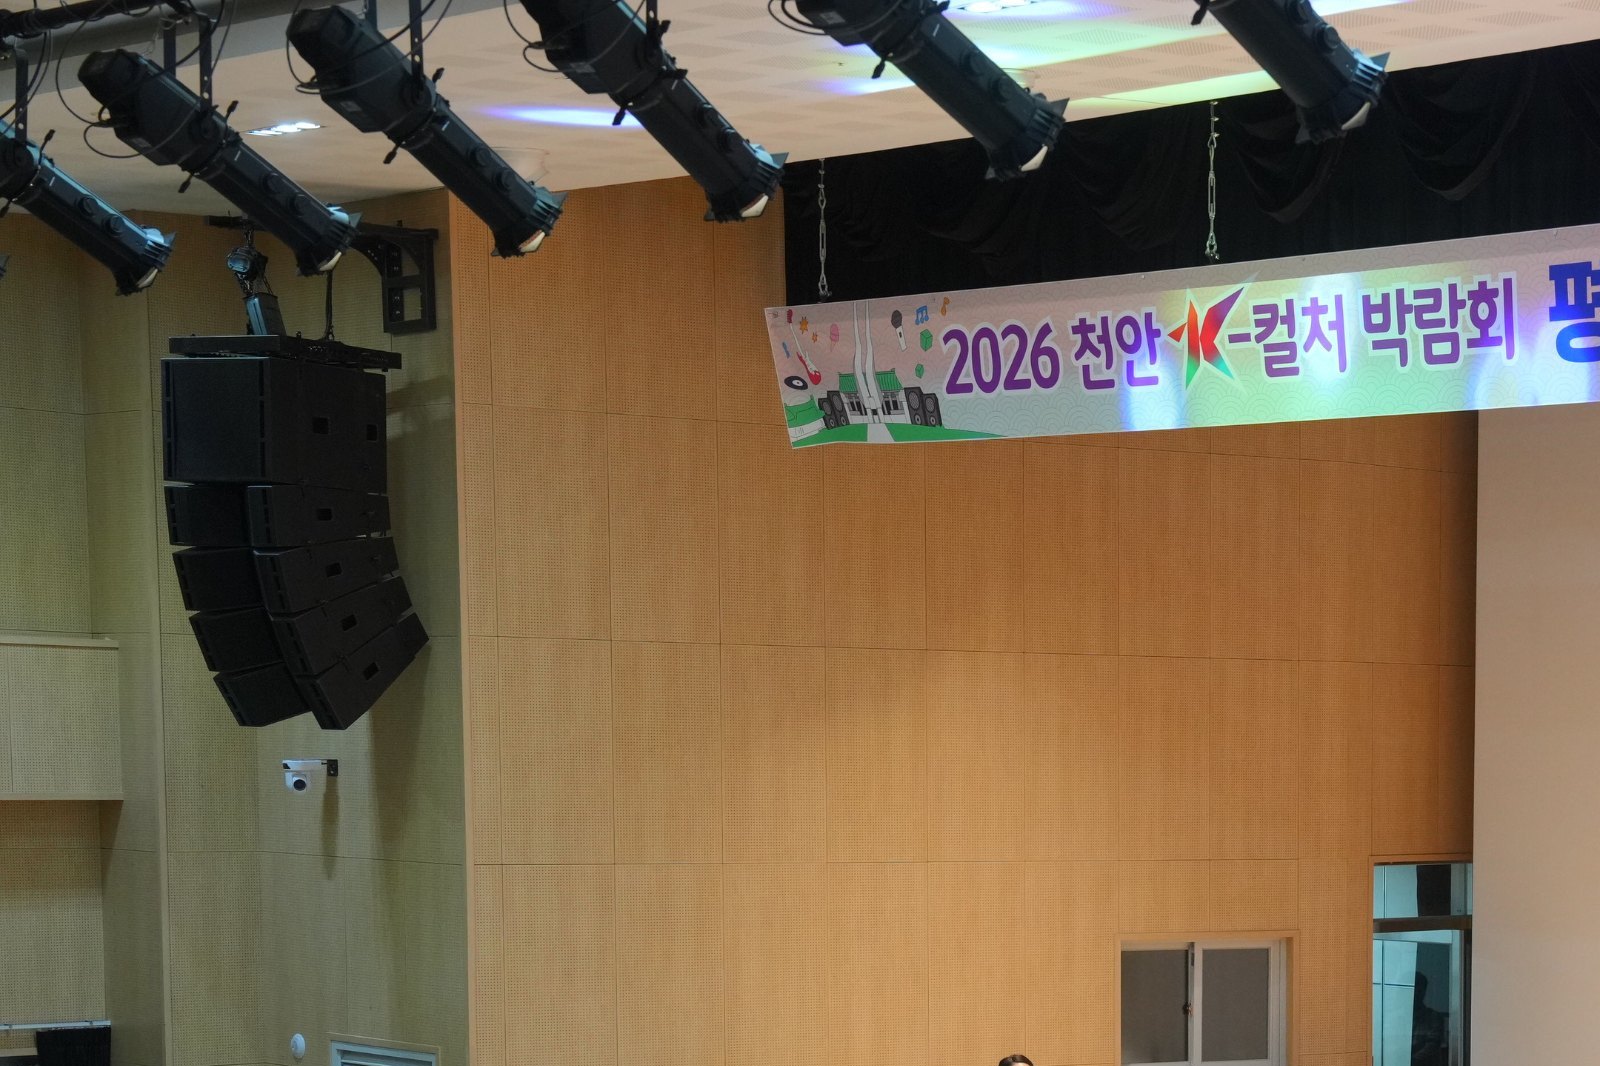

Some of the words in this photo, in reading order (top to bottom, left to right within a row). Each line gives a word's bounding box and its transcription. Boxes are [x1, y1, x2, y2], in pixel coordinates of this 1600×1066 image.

[942, 321, 1061, 395] 2026
[1071, 311, 1162, 389] 천안
[1362, 277, 1516, 368] 박람회
